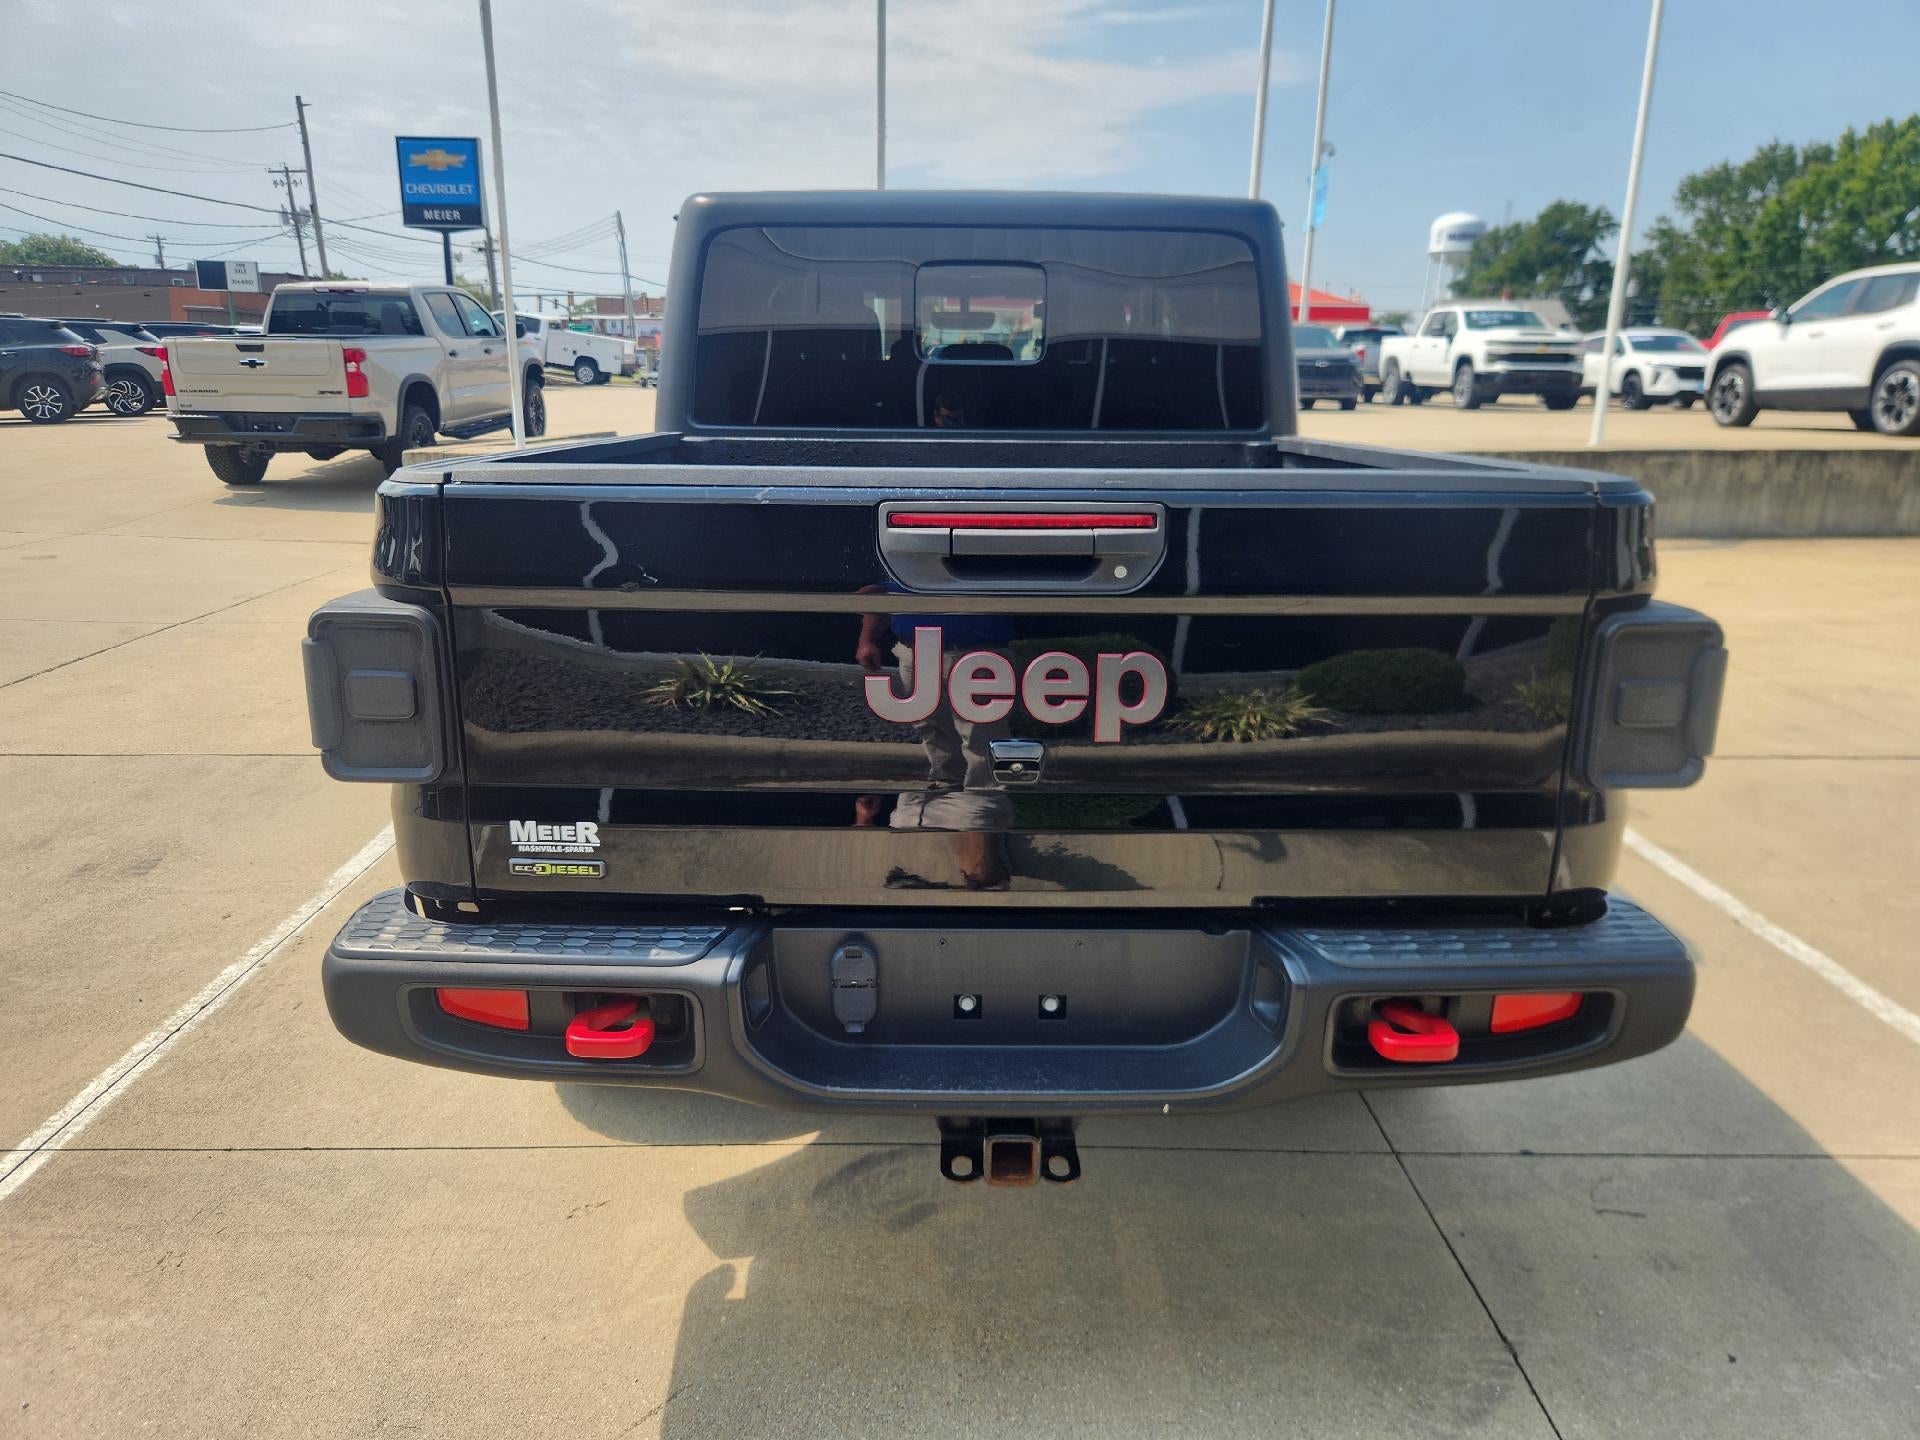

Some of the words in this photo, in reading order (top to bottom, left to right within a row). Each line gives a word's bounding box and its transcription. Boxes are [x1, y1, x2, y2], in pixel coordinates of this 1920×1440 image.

[406, 183, 473, 195] CHEVROLET
[423, 209, 461, 220] MEIER
[864, 626, 1168, 743] Jeep
[509, 820, 600, 844] MEIER
[519, 845, 594, 853] NASHVILLE-SPARTA
